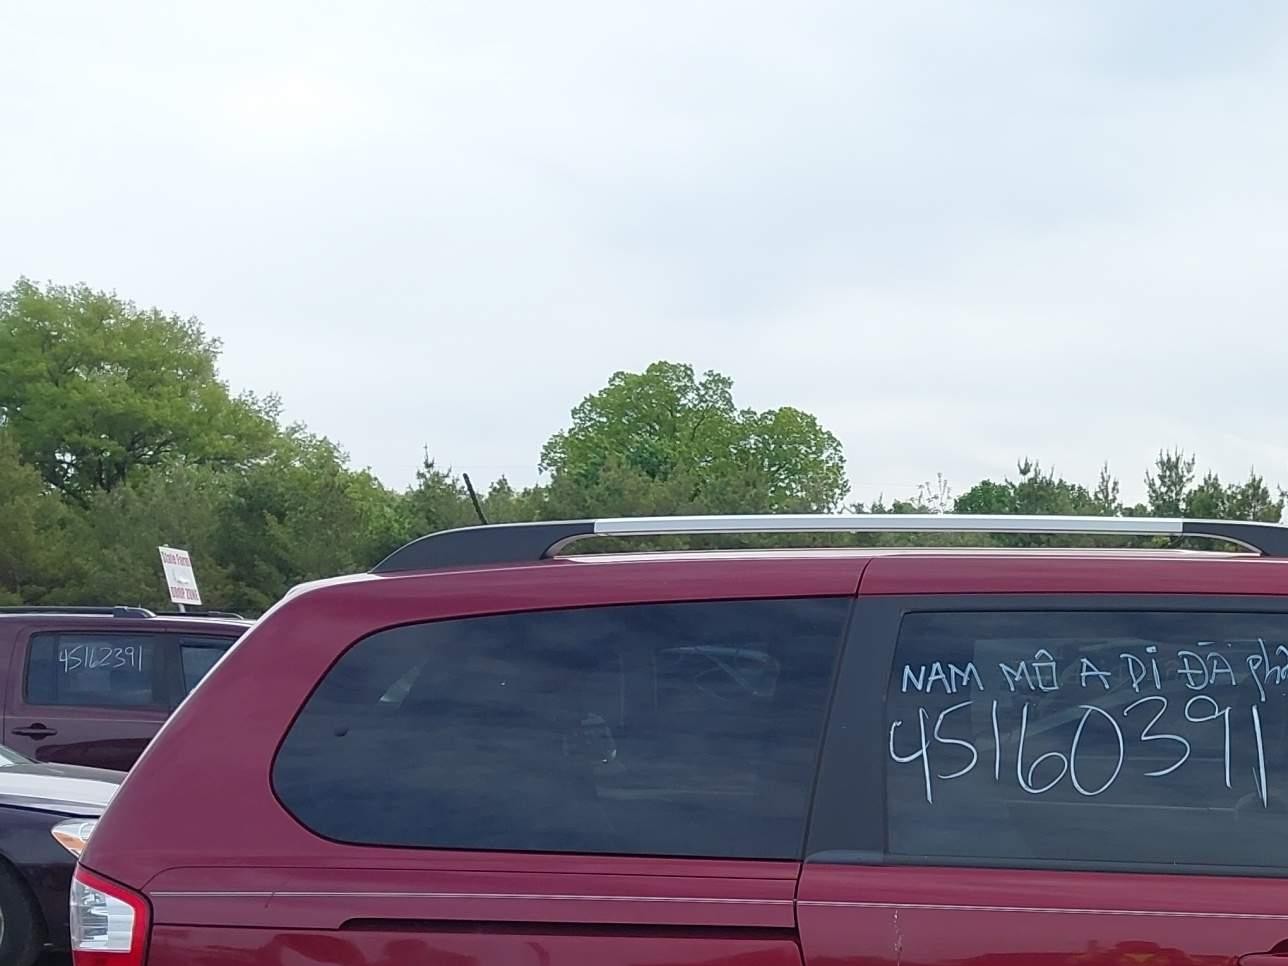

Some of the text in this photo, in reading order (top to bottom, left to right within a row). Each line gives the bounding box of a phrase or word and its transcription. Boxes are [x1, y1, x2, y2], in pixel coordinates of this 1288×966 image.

[59, 644, 142, 673] 45162391
[902, 661, 984, 694] NAM
[1080, 658, 1112, 689] A
[889, 695, 1268, 808] 45160391
